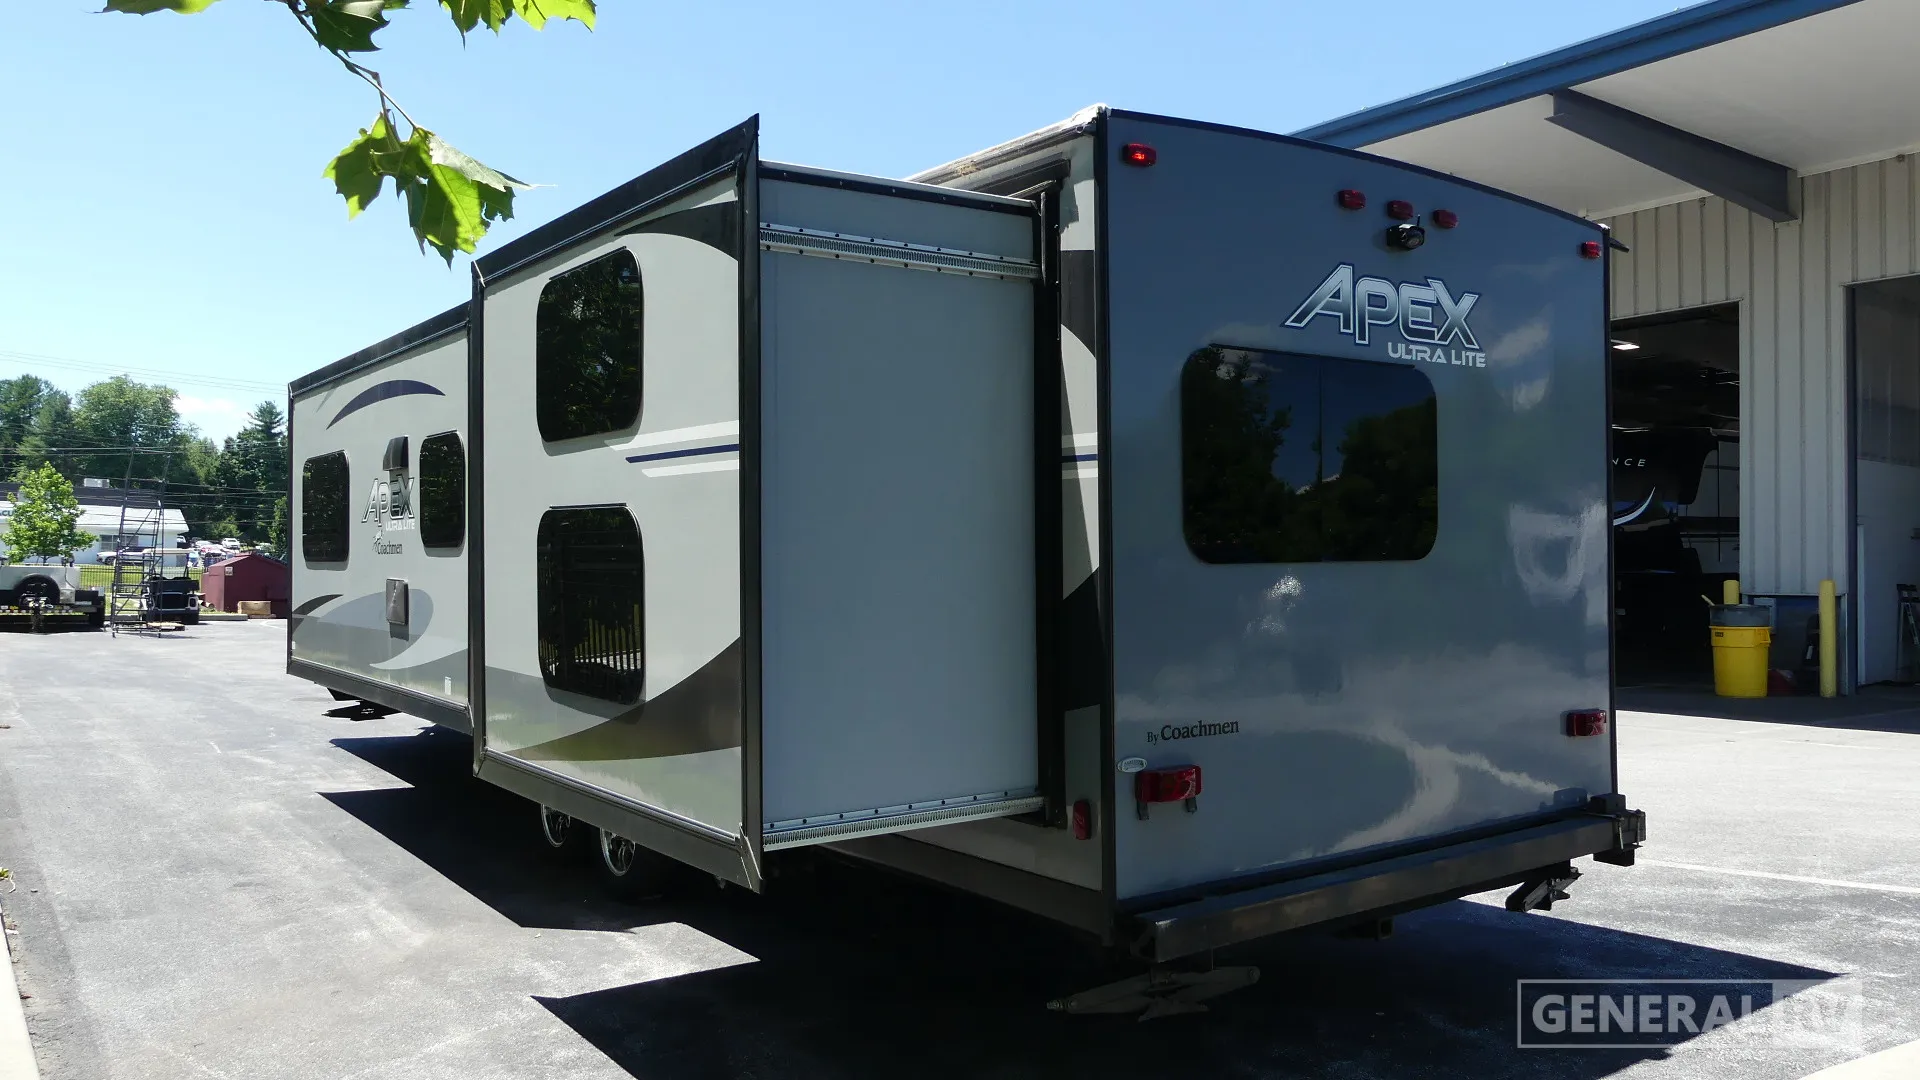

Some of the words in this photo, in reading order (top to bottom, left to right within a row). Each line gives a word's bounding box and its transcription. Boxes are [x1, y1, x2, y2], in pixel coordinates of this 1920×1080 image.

[1387, 342, 1448, 364] ULTRA
[1451, 350, 1486, 368] LITE
[1146, 731, 1159, 745] By
[1160, 720, 1240, 741] Coachmen
